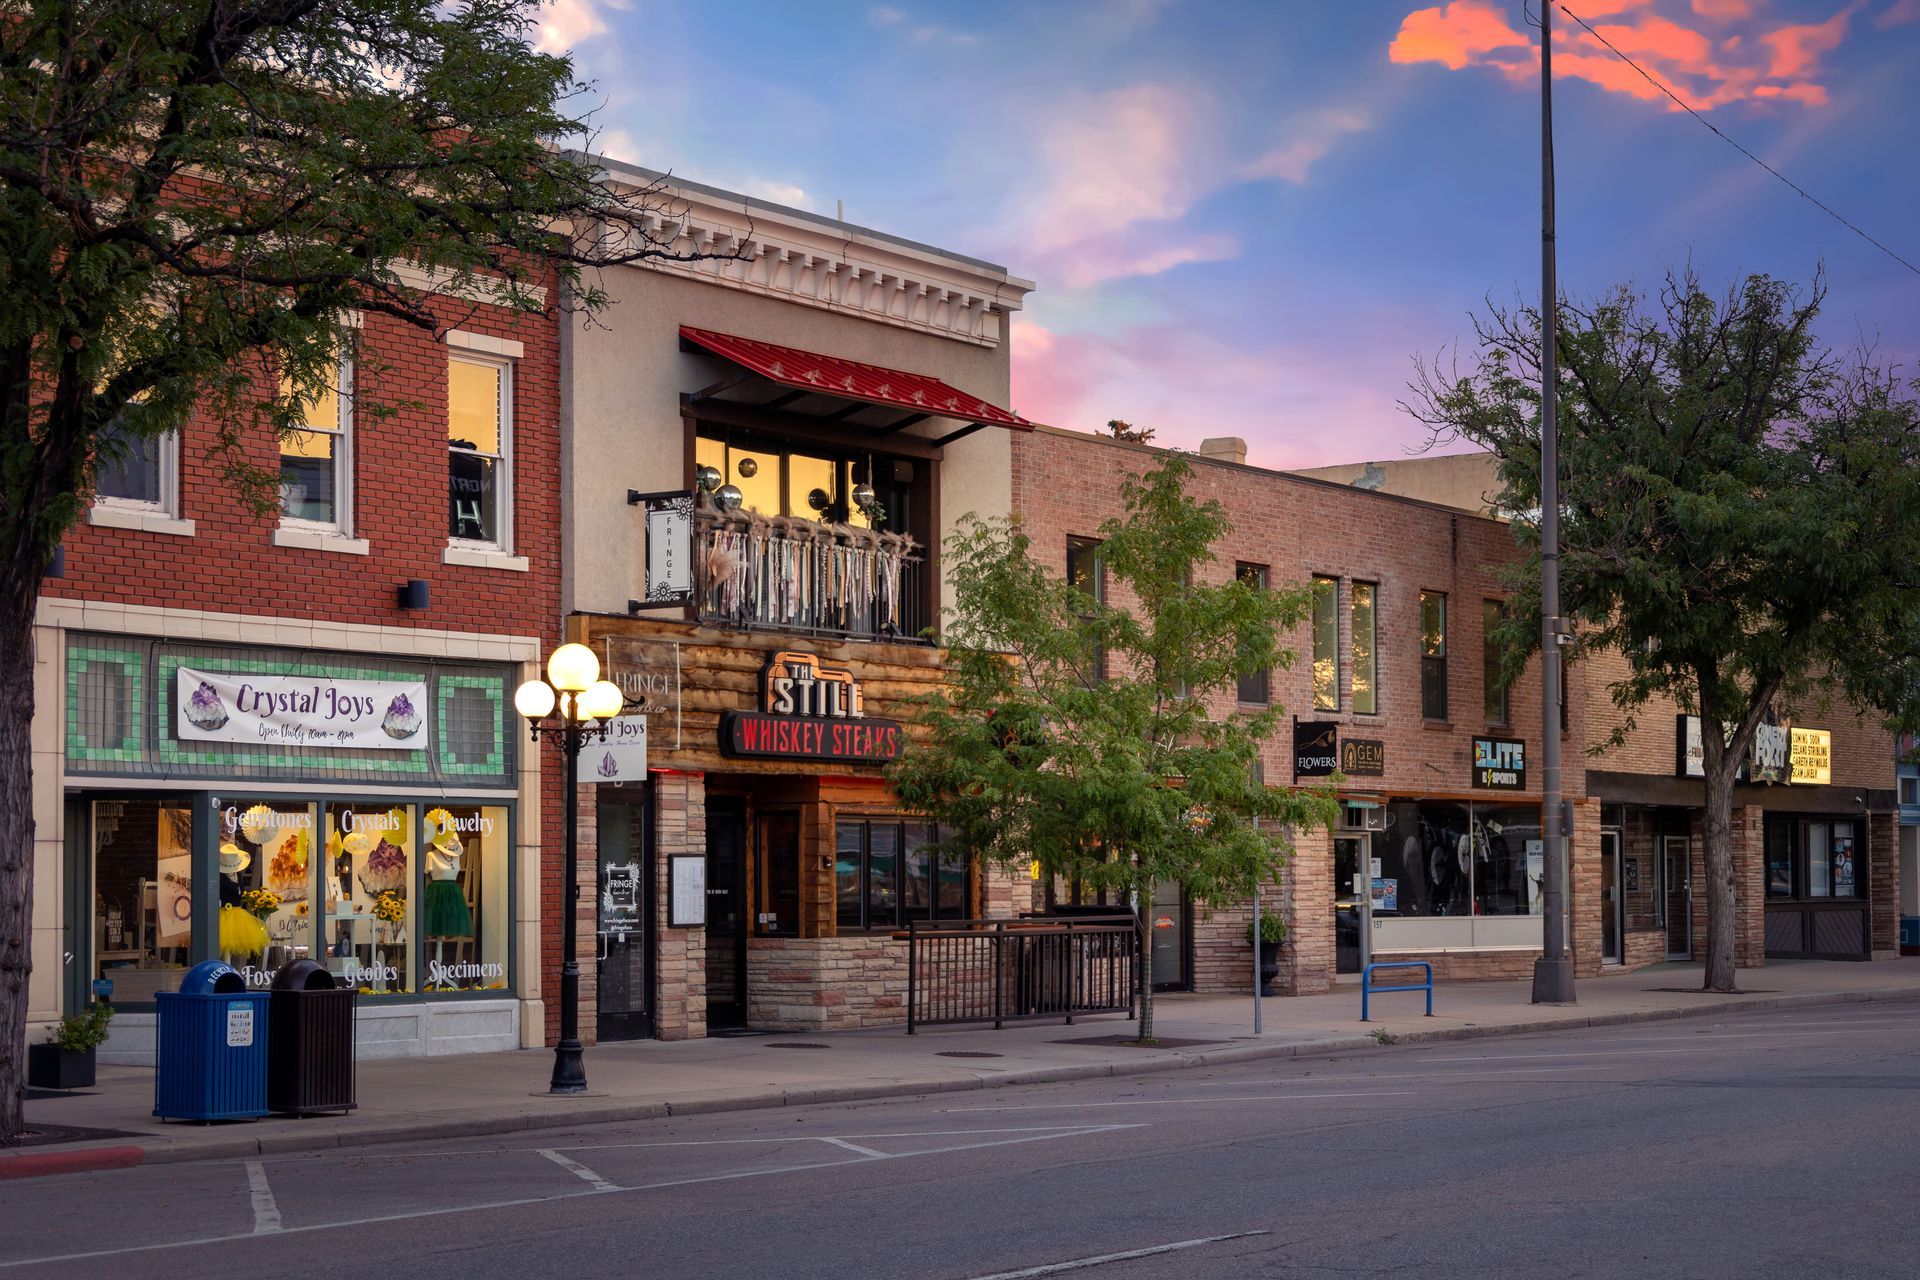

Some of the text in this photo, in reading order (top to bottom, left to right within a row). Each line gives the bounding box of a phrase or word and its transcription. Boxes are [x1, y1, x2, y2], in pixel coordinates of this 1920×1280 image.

[615, 671, 673, 695] FRINGE
[792, 664, 815, 680] THE
[236, 683, 375, 722] Crystal Joys
[773, 678, 864, 719] STILL
[258, 722, 279, 741] Open
[280, 723, 305, 744] Daily
[617, 721, 645, 738] Joys
[742, 718, 896, 757] WHISKEY STEAKS
[1809, 734, 1820, 745] SOON
[1298, 756, 1336, 769] FLOWERS
[1357, 745, 1382, 761] GEM
[1475, 740, 1524, 770] ELITE
[1808, 757, 1828, 768] REYNOLDS
[225, 806, 312, 834] Gemstones
[341, 809, 401, 833] Crystals
[438, 811, 494, 837] Jewelry
[610, 880, 633, 888] FRINGE
[344, 960, 398, 989] Geodes
[429, 959, 504, 985] Specimens
